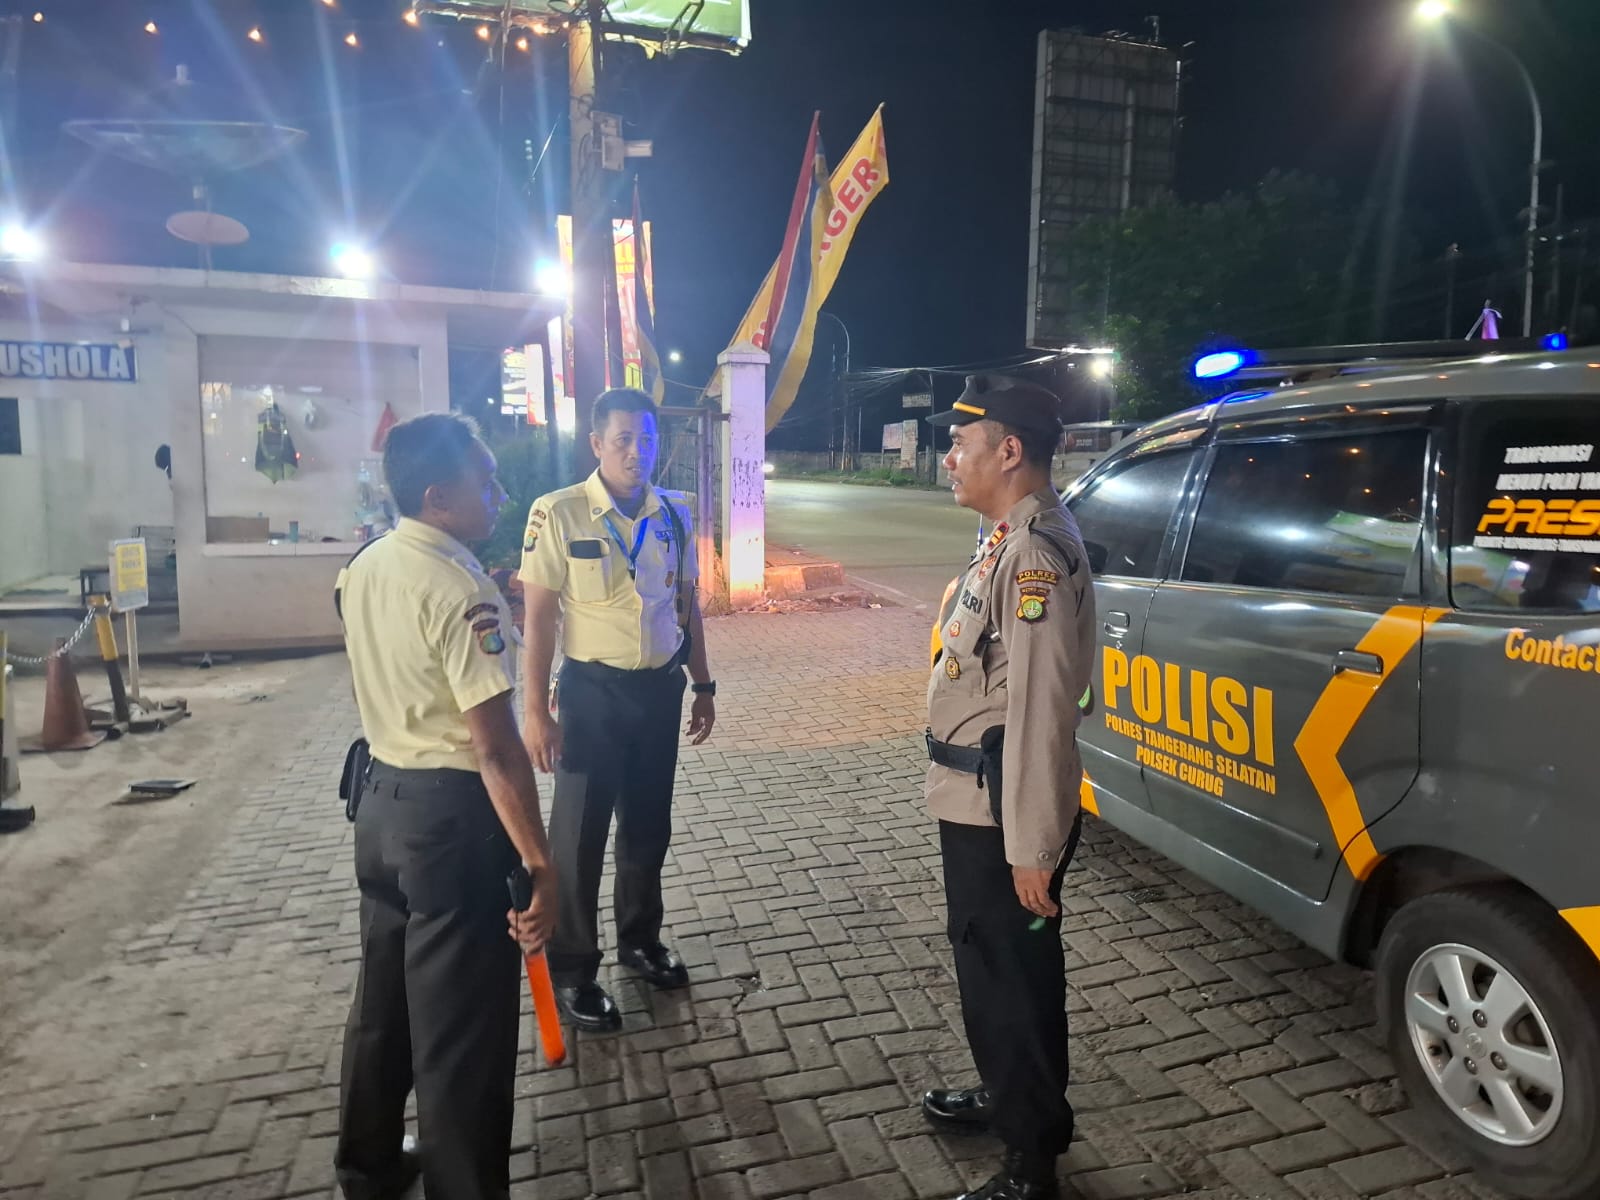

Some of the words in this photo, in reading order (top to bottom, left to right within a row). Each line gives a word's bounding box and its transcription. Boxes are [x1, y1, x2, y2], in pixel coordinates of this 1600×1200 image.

[820, 158, 880, 251] GER
[1477, 498, 1600, 536] PRES
[1103, 645, 1274, 767] POLISI
[1105, 712, 1143, 742] POLRES
[1143, 727, 1214, 770] TANGERANG
[1215, 754, 1276, 796] SELATAN
[1136, 744, 1177, 778] POLSEK
[1179, 762, 1224, 798] CURUG
